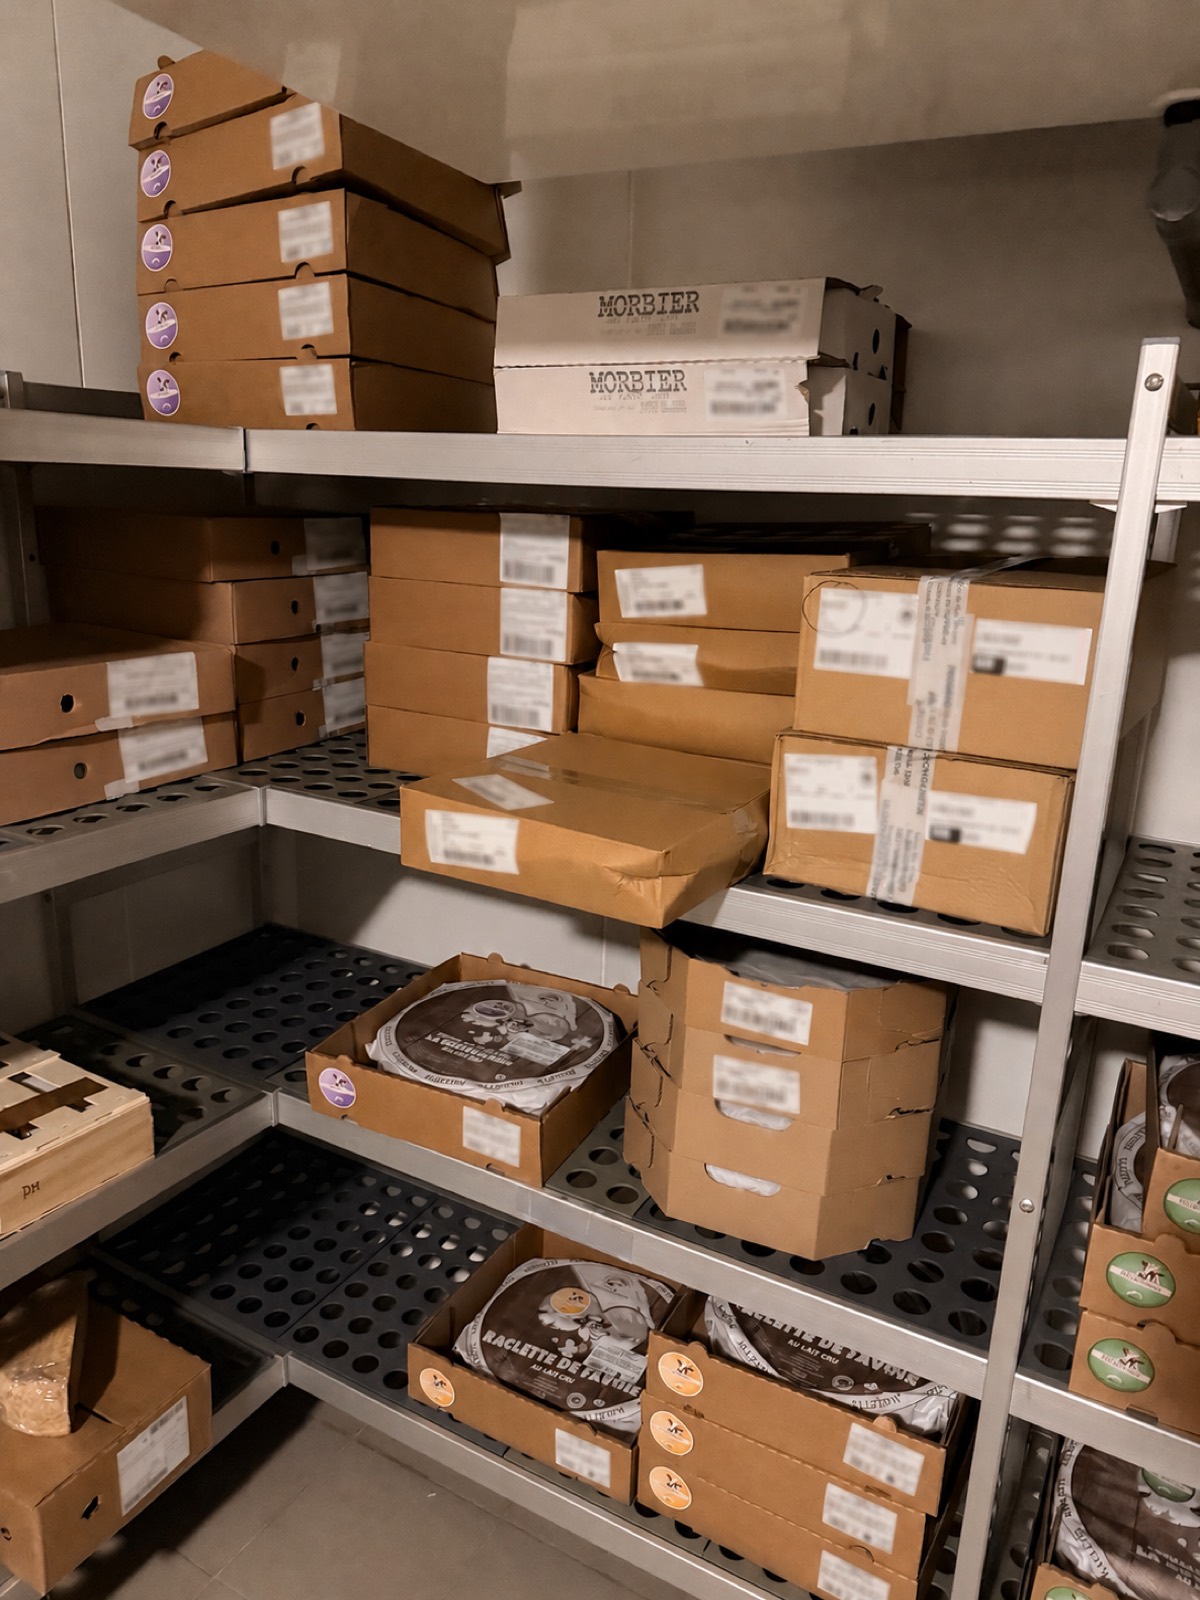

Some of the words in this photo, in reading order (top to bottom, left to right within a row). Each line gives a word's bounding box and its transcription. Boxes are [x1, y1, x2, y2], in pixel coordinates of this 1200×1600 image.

[597, 290, 700, 318] MORBIER
[588, 369, 688, 394] MORBIER
[481, 1329, 559, 1366] RACLETTE
[556, 1357, 582, 1375] DE
[787, 1338, 800, 1349] AU
[800, 1344, 821, 1360] LAIT
[820, 1352, 840, 1366] CRU
[818, 1335, 845, 1357] DE
